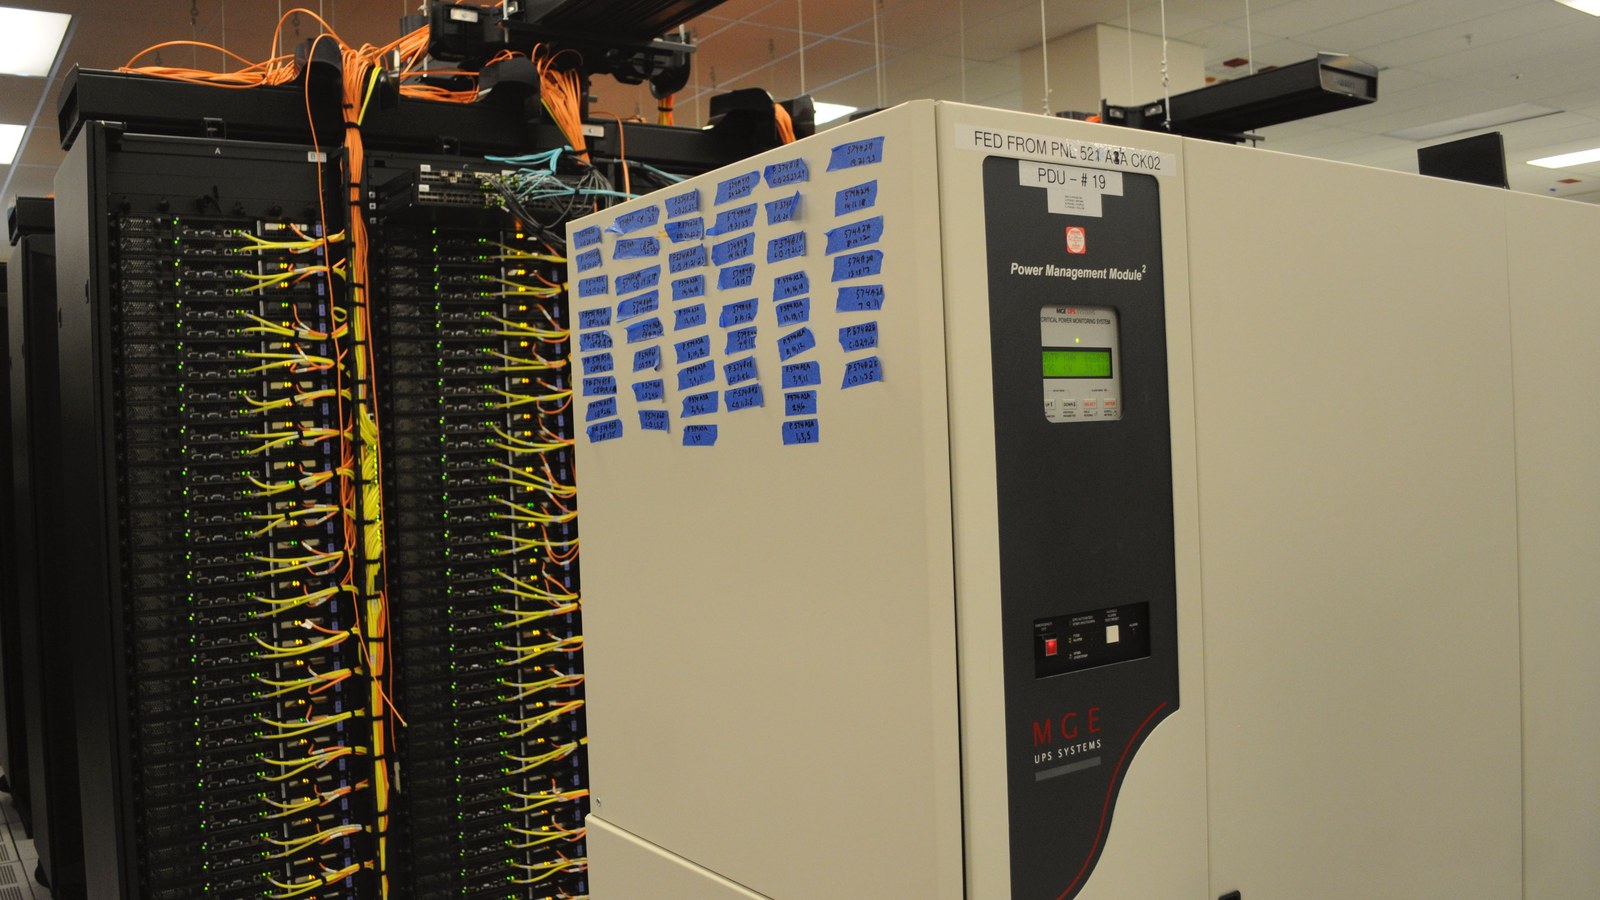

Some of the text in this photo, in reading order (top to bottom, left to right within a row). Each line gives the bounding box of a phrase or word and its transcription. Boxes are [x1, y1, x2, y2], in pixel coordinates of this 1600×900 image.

[974, 131, 1002, 149] FED
[1008, 136, 1047, 156] FROM
[1052, 141, 1076, 160] PNL
[1131, 152, 1160, 170] CK02
[1038, 168, 1066, 185] PDU
[1092, 174, 1106, 190] 19
[1010, 262, 1043, 276] Power
[1045, 264, 1107, 280] Management
[1033, 707, 1101, 748] MGE
[1034, 739, 1101, 764] UPS SYSTEMS
